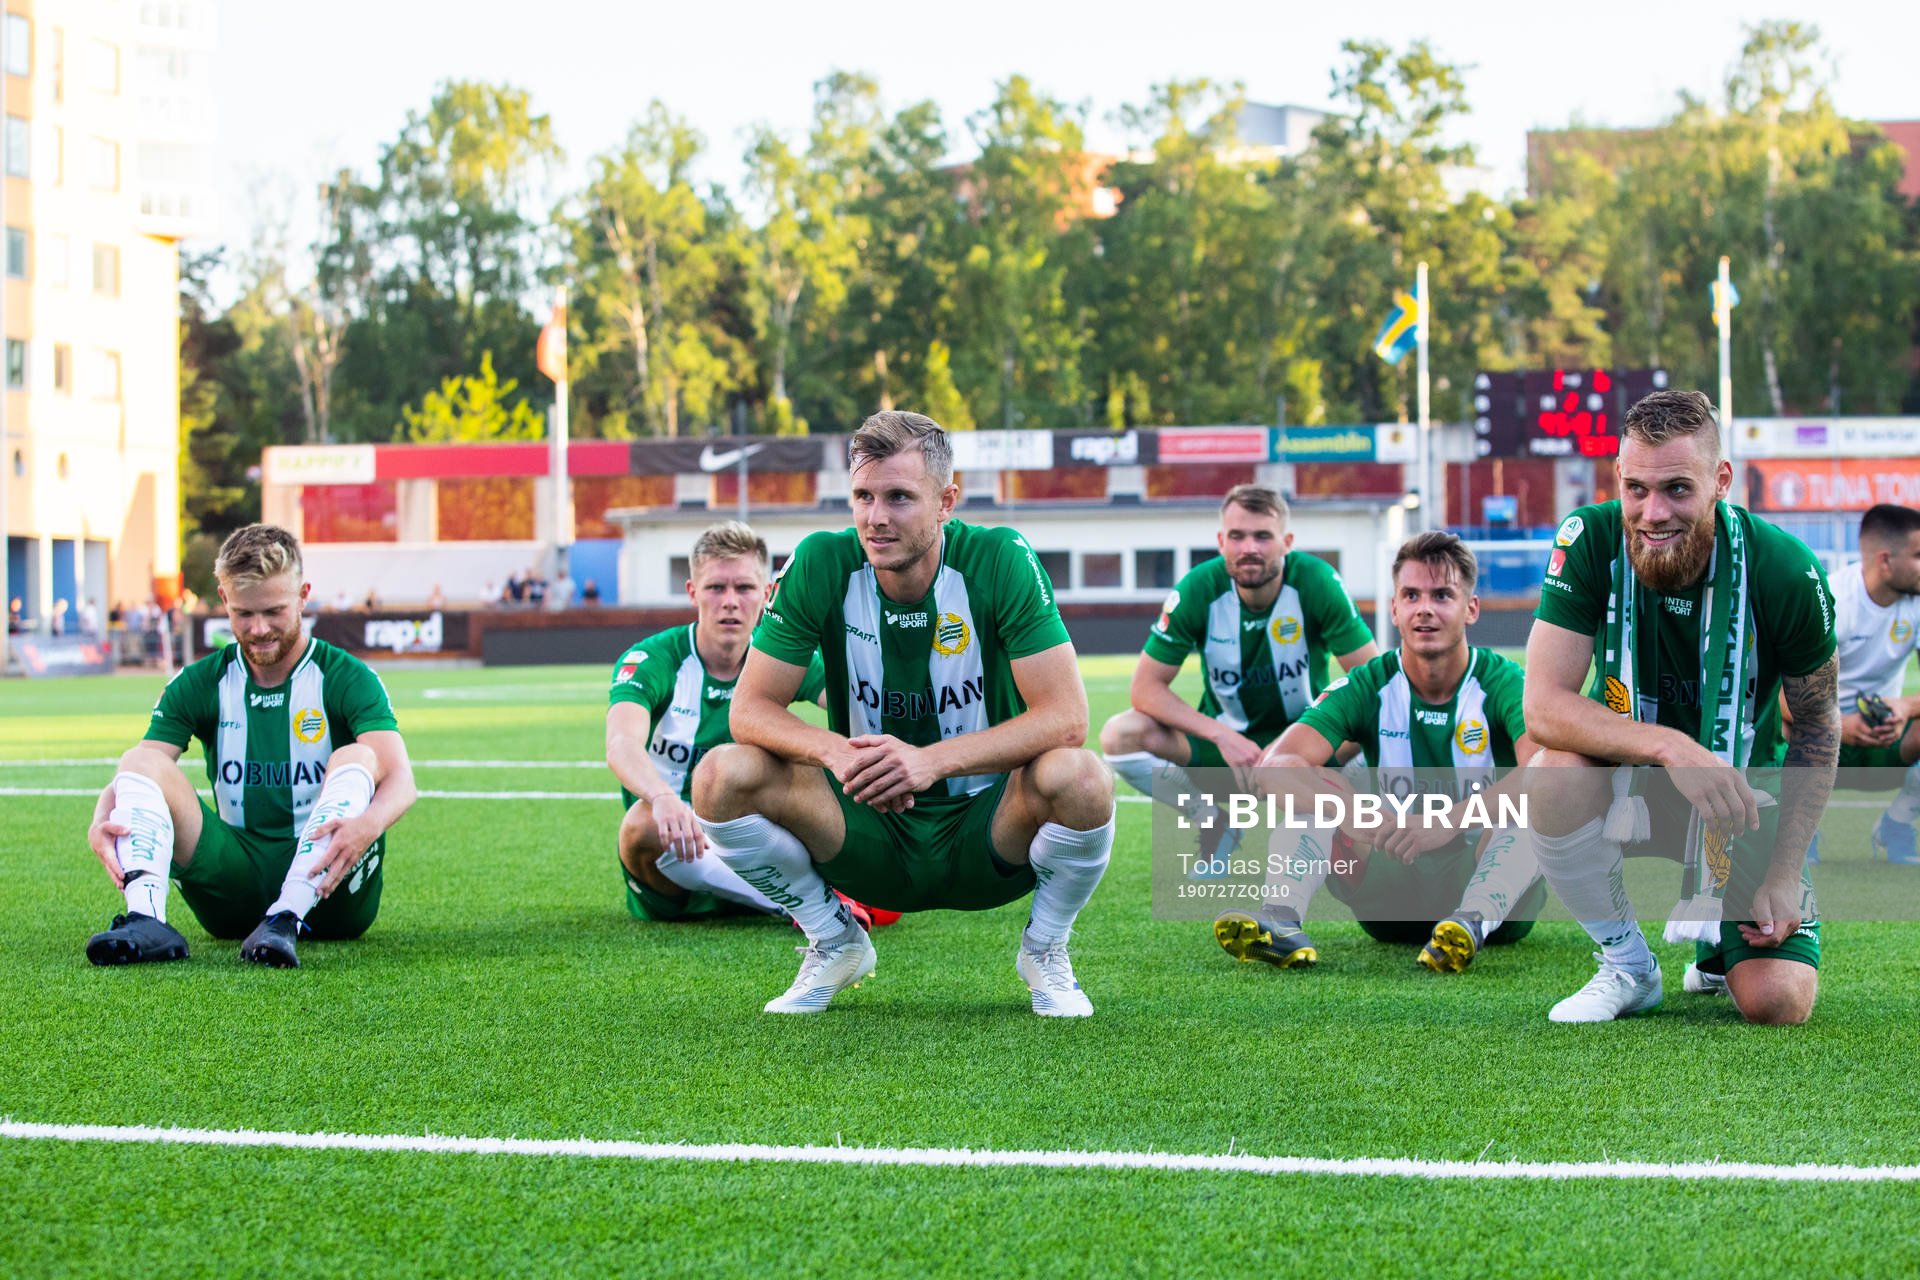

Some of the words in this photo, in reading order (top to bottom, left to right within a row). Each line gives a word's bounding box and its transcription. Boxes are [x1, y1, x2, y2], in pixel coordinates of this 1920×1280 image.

[899, 612, 928, 621] INTER
[899, 620, 928, 629] SPORT
[845, 623, 876, 642] CRAFT
[262, 693, 285, 702] INTER
[262, 700, 284, 708] SPORT
[1424, 710, 1449, 719] INTER
[1423, 718, 1448, 726] SPORT
[219, 759, 327, 788] OBMAN
